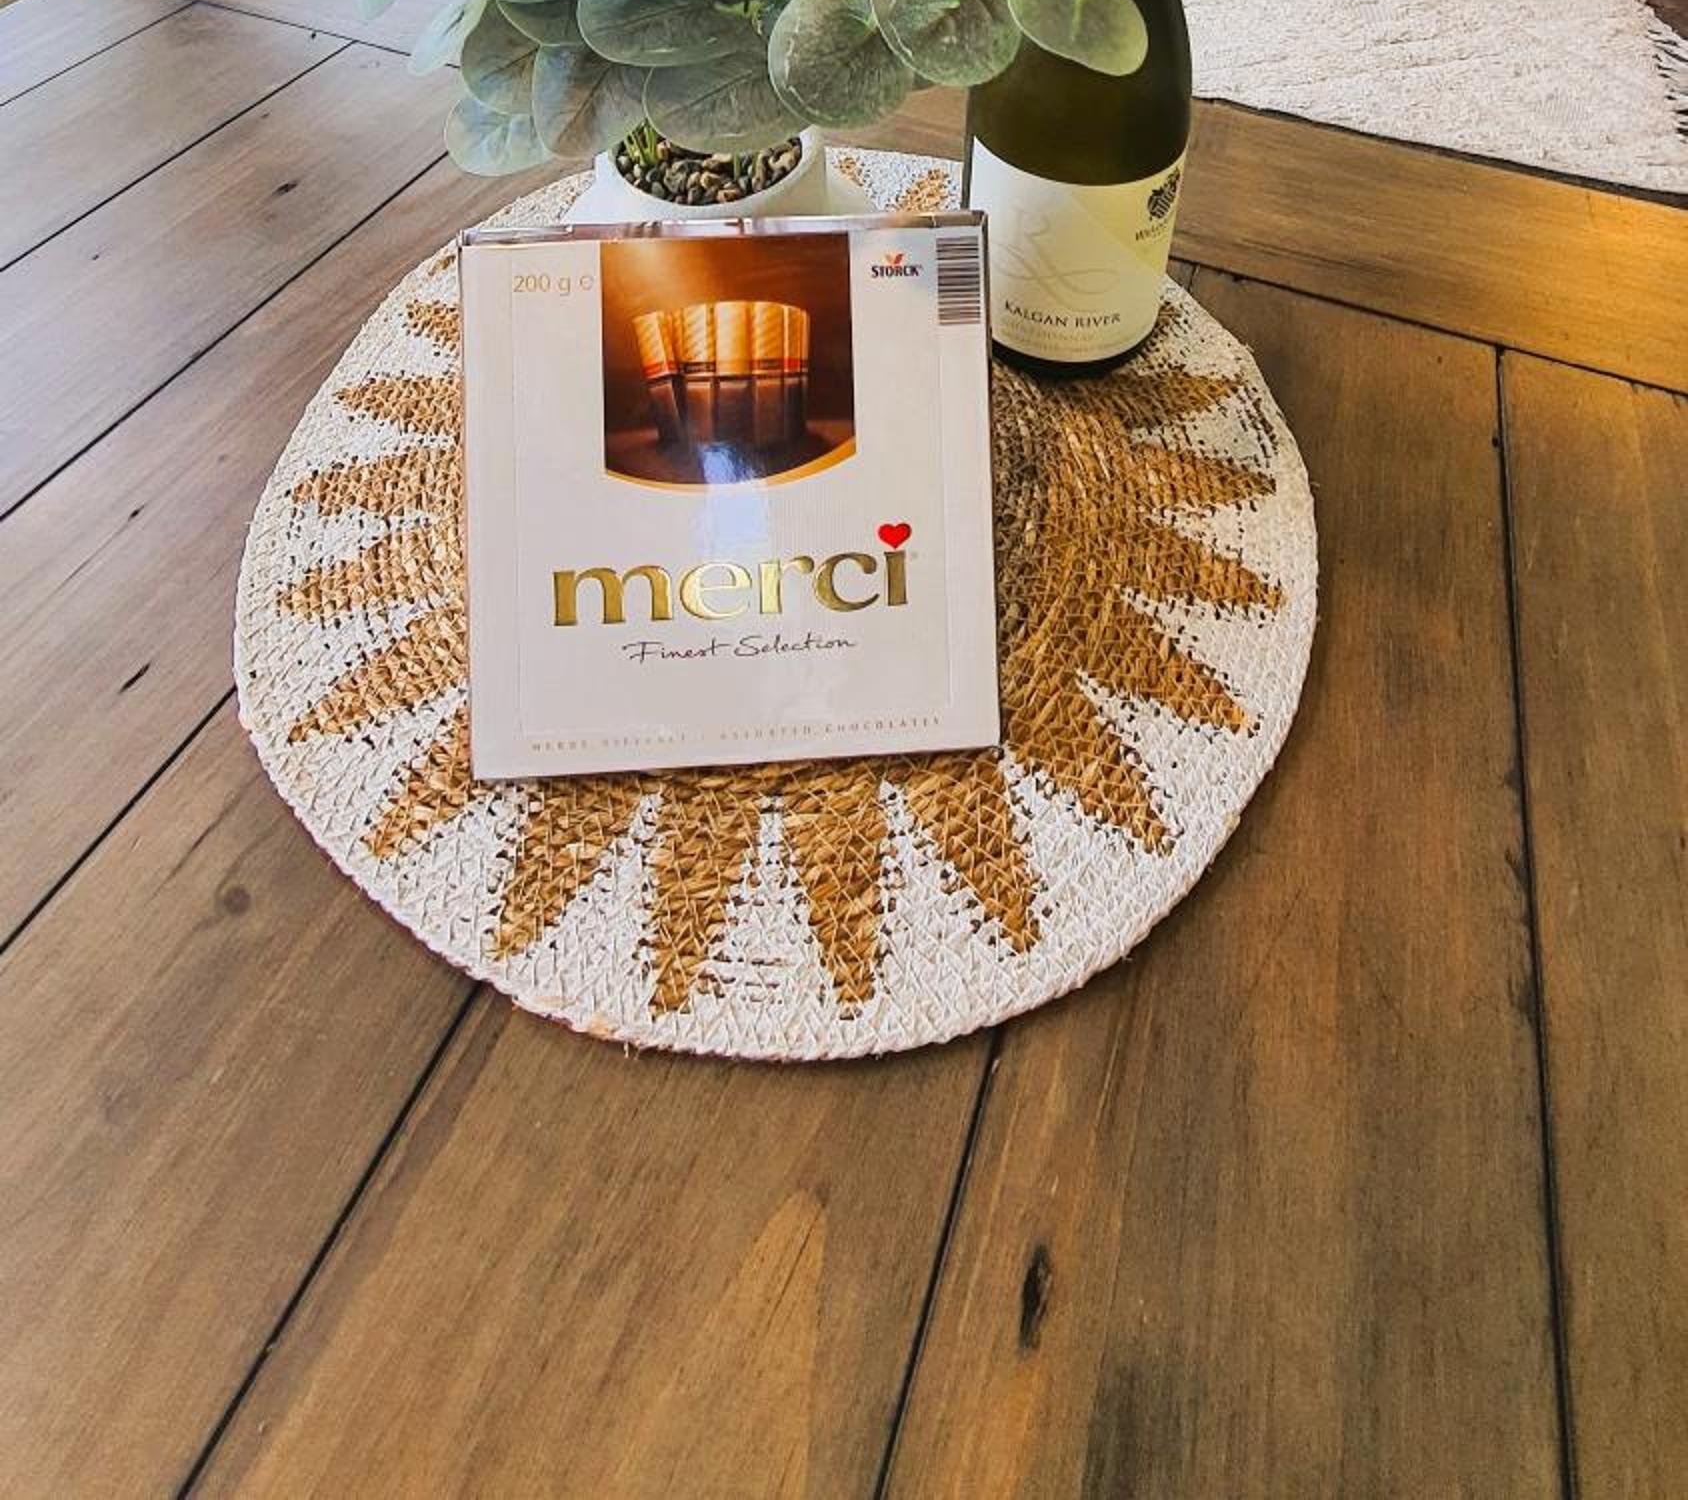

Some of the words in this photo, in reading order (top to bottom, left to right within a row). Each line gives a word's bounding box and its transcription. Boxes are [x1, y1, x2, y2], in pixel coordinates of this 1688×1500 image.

[513, 273, 551, 293] 200
[557, 276, 571, 297] g
[871, 264, 921, 279] STORCK
[1005, 299, 1068, 327] KALGAN
[1075, 313, 1121, 327] RIVER
[552, 522, 912, 627] merci
[622, 637, 732, 664] Finest
[733, 632, 857, 658] Selection
